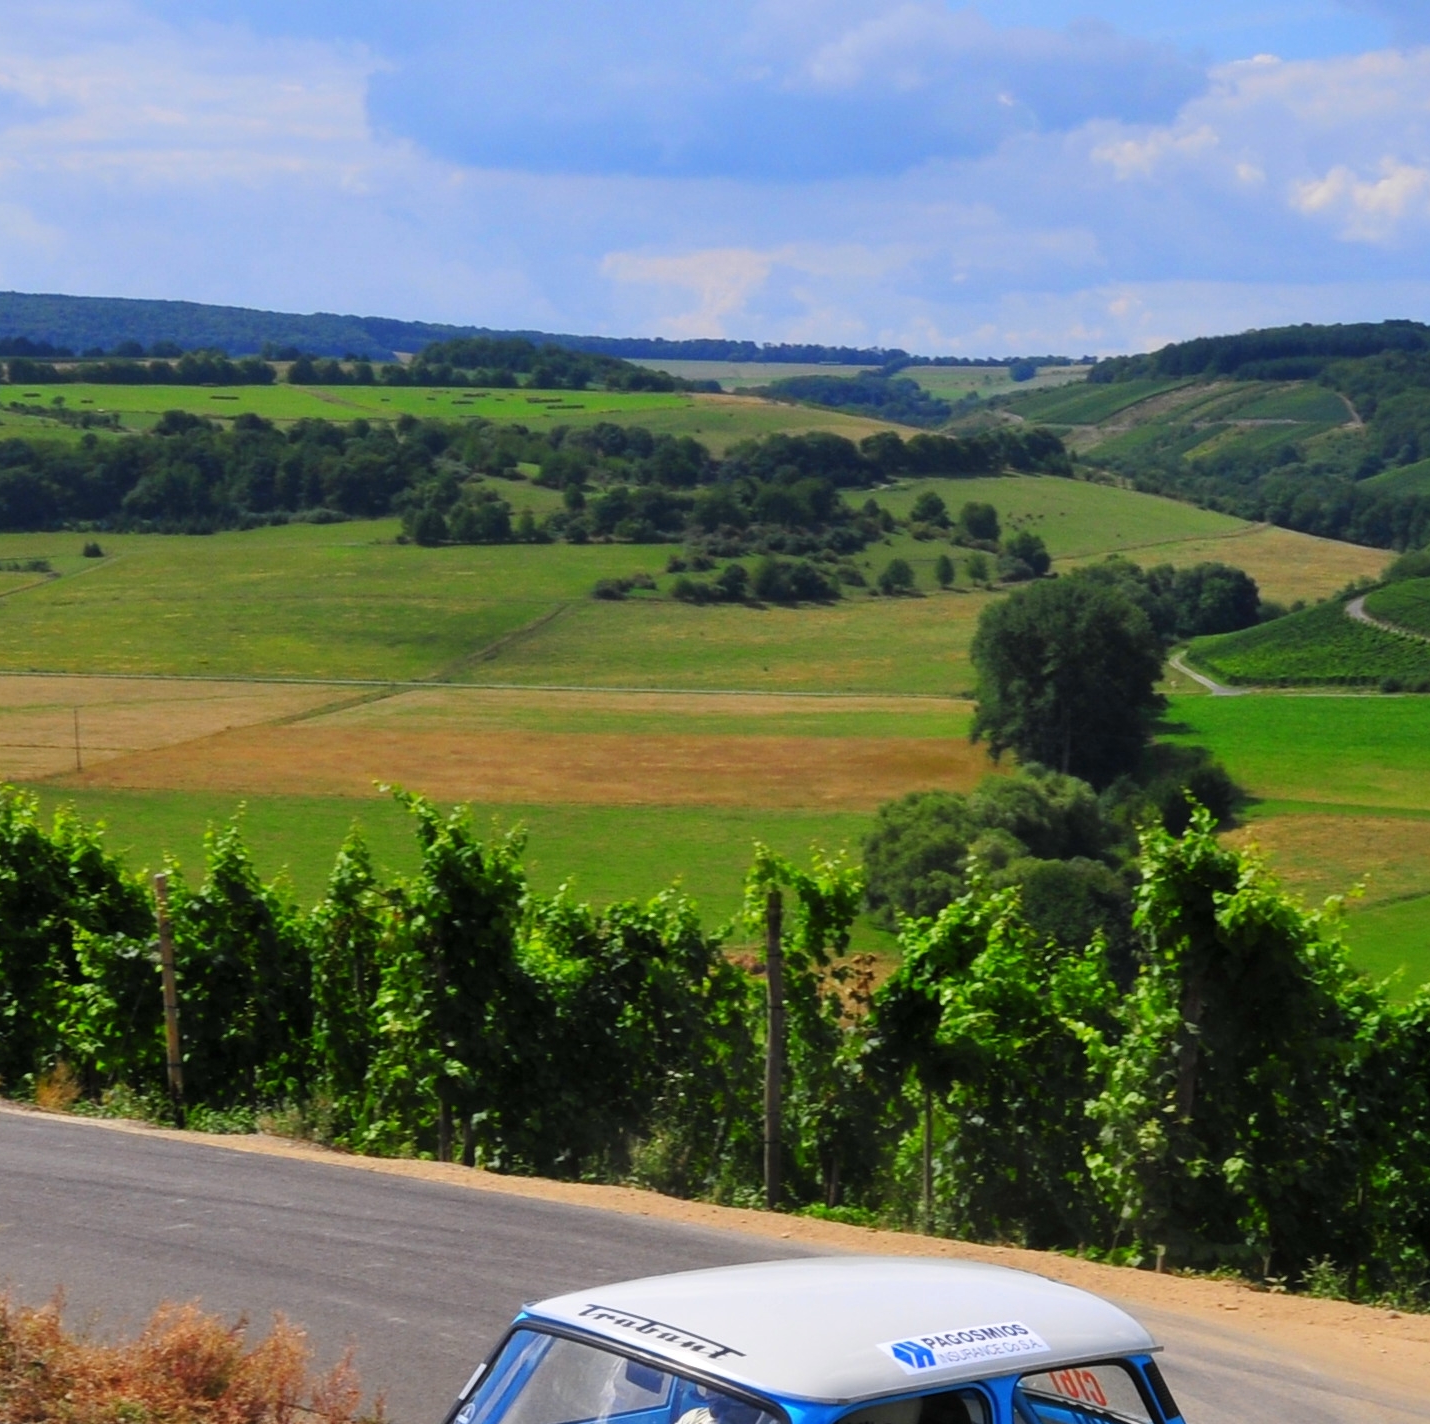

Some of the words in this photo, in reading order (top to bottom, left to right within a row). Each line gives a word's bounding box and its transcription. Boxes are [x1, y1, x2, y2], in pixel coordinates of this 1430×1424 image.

[578, 1303, 747, 1360] Trabant
[922, 1324, 1029, 1350] PAGOSMIOS
[937, 1345, 1002, 1364] INSURANCE
